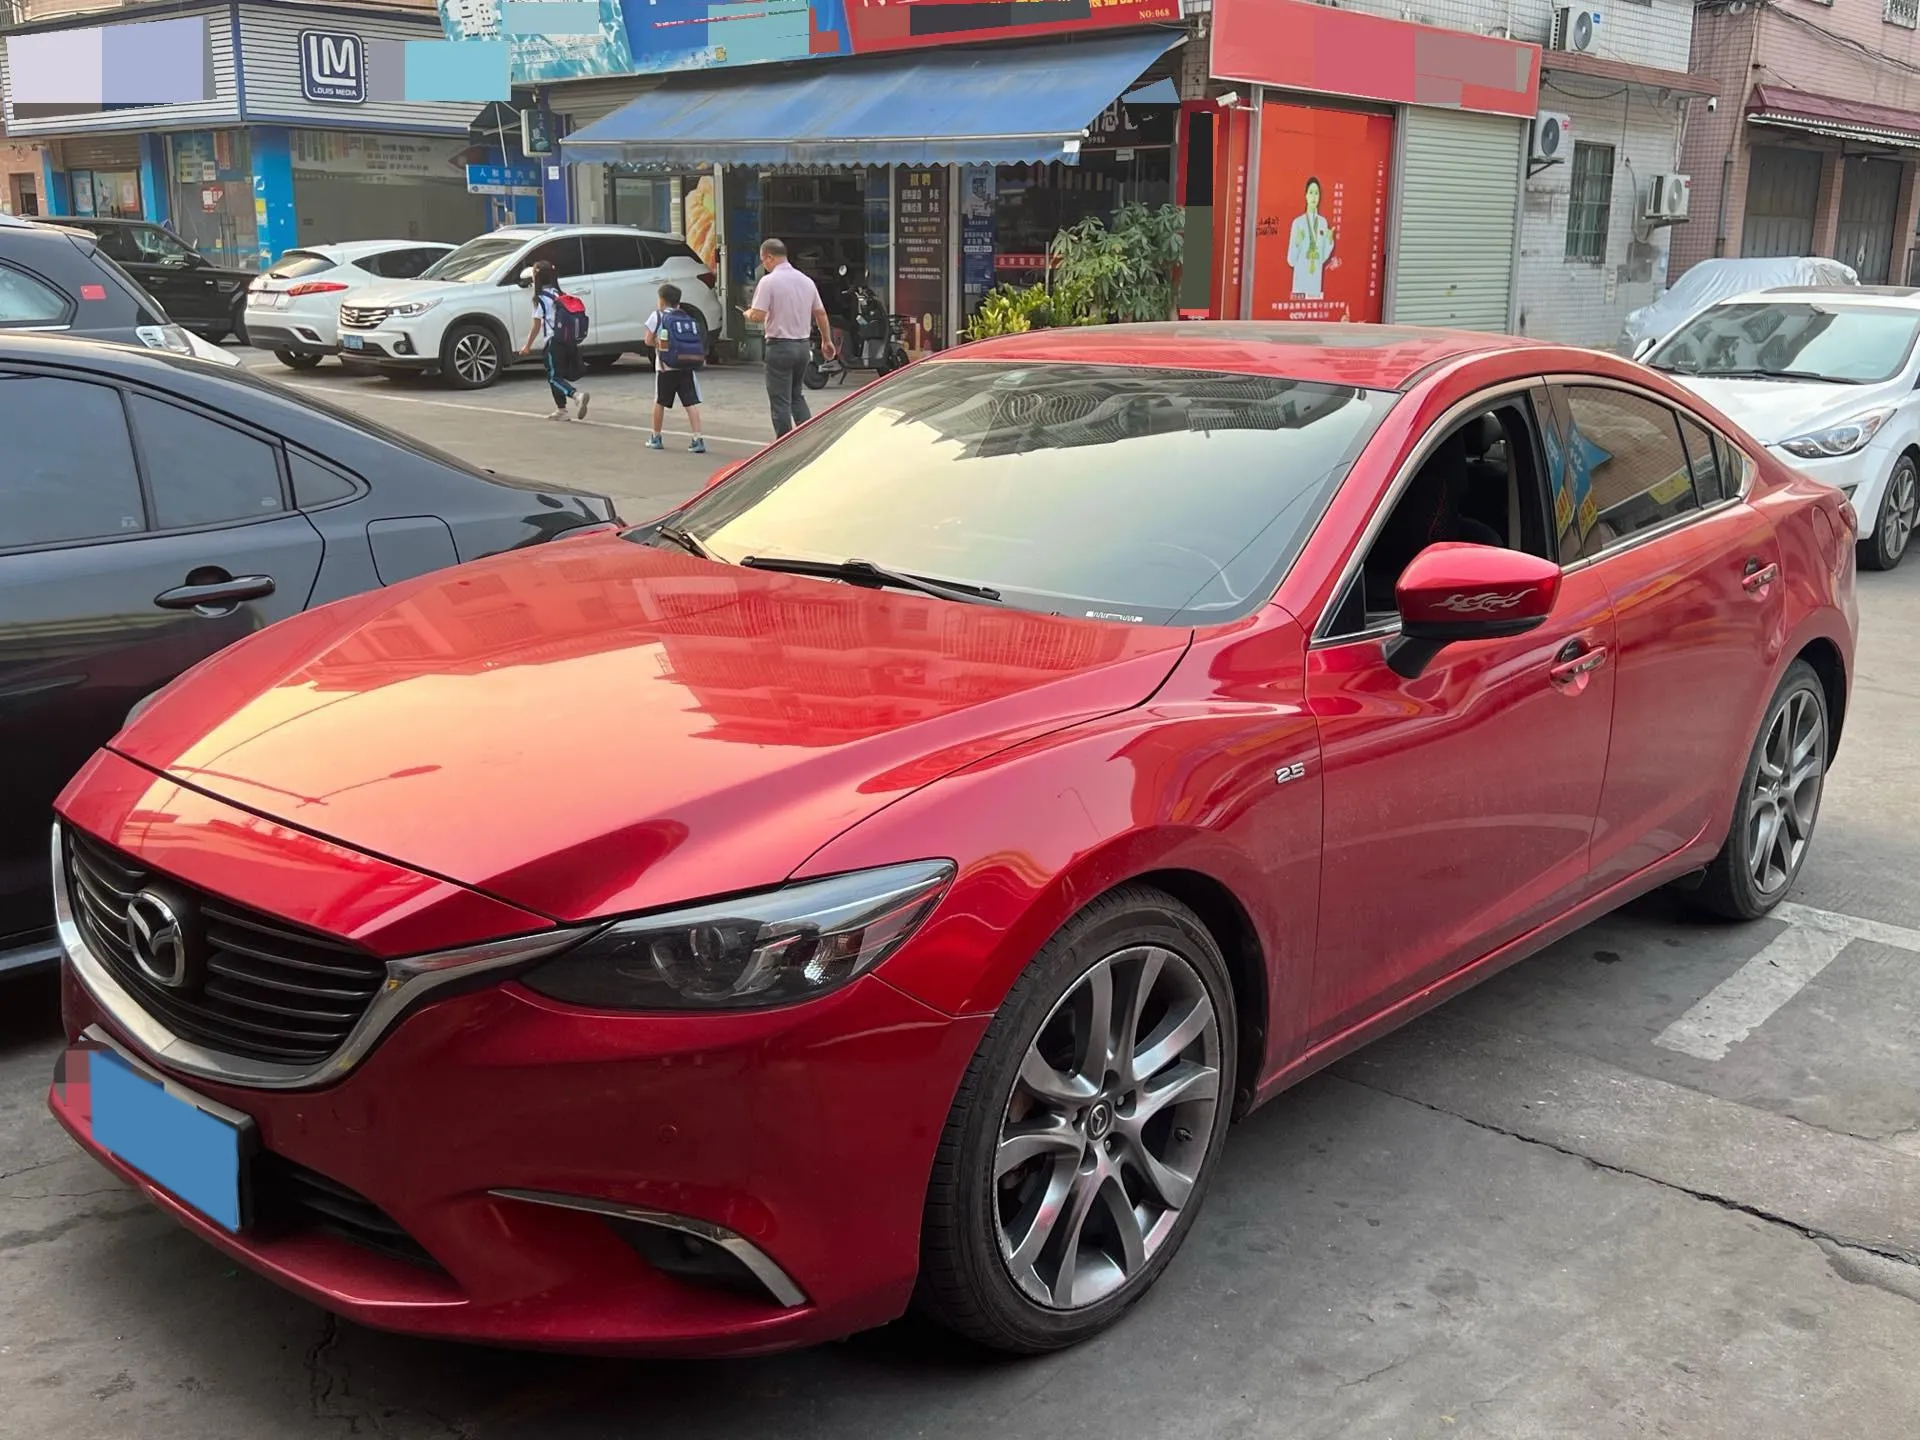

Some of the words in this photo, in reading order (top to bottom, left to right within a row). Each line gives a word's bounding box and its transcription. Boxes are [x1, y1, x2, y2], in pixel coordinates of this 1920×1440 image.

[309, 35, 357, 87] LM
[313, 87, 334, 96] LOUIS
[335, 88, 358, 97] MEDIA
